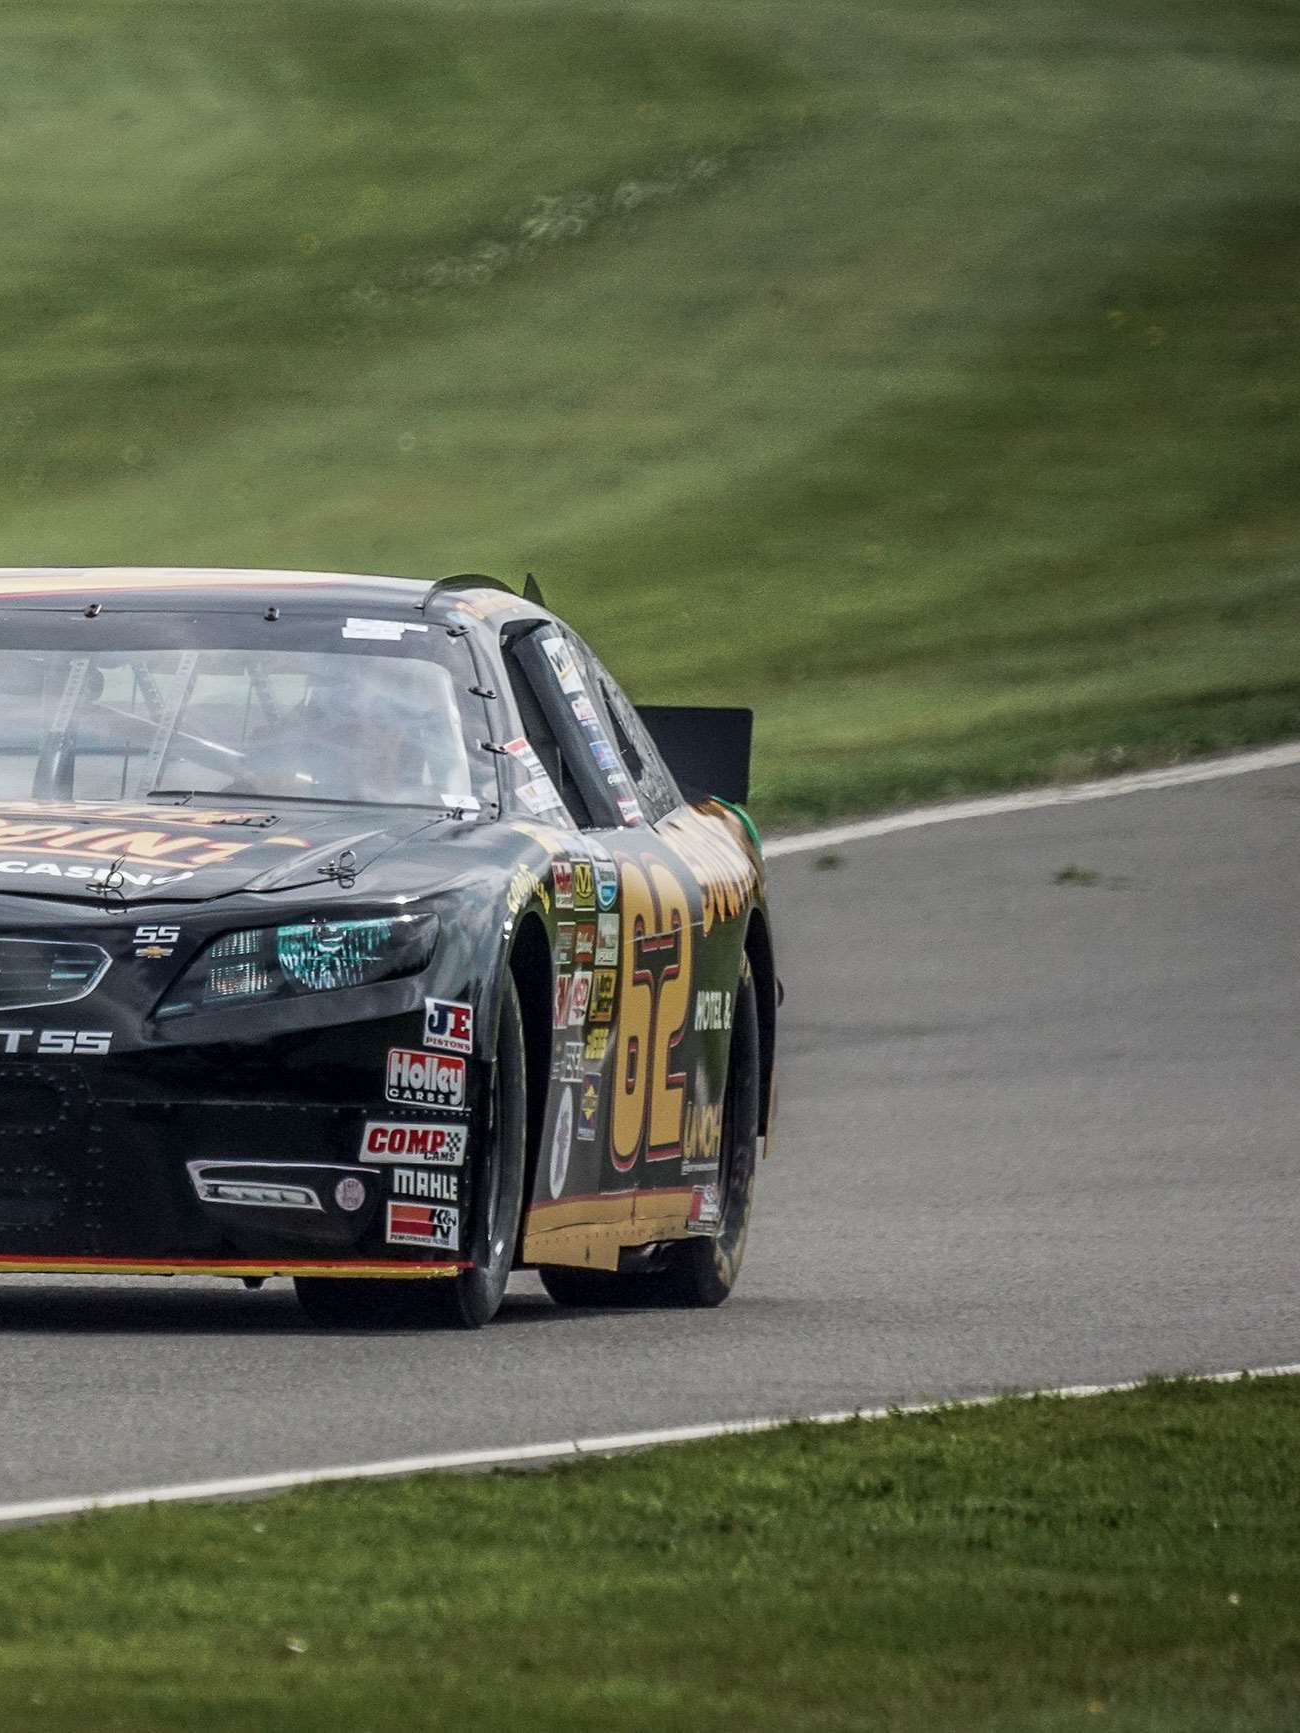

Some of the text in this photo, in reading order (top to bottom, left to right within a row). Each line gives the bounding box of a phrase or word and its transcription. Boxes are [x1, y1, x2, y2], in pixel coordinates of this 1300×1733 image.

[132, 926, 181, 943] SS
[427, 1002, 471, 1041] JE
[609, 856, 694, 1172] 62
[36, 1029, 114, 1055] SS
[425, 1036, 471, 1052] PISTONS
[389, 1053, 463, 1106] Holley
[388, 1088, 446, 1104] CARBS
[367, 1128, 446, 1155] COMP
[424, 1151, 456, 1163] CAMS
[393, 1168, 458, 1201] MAHLE
